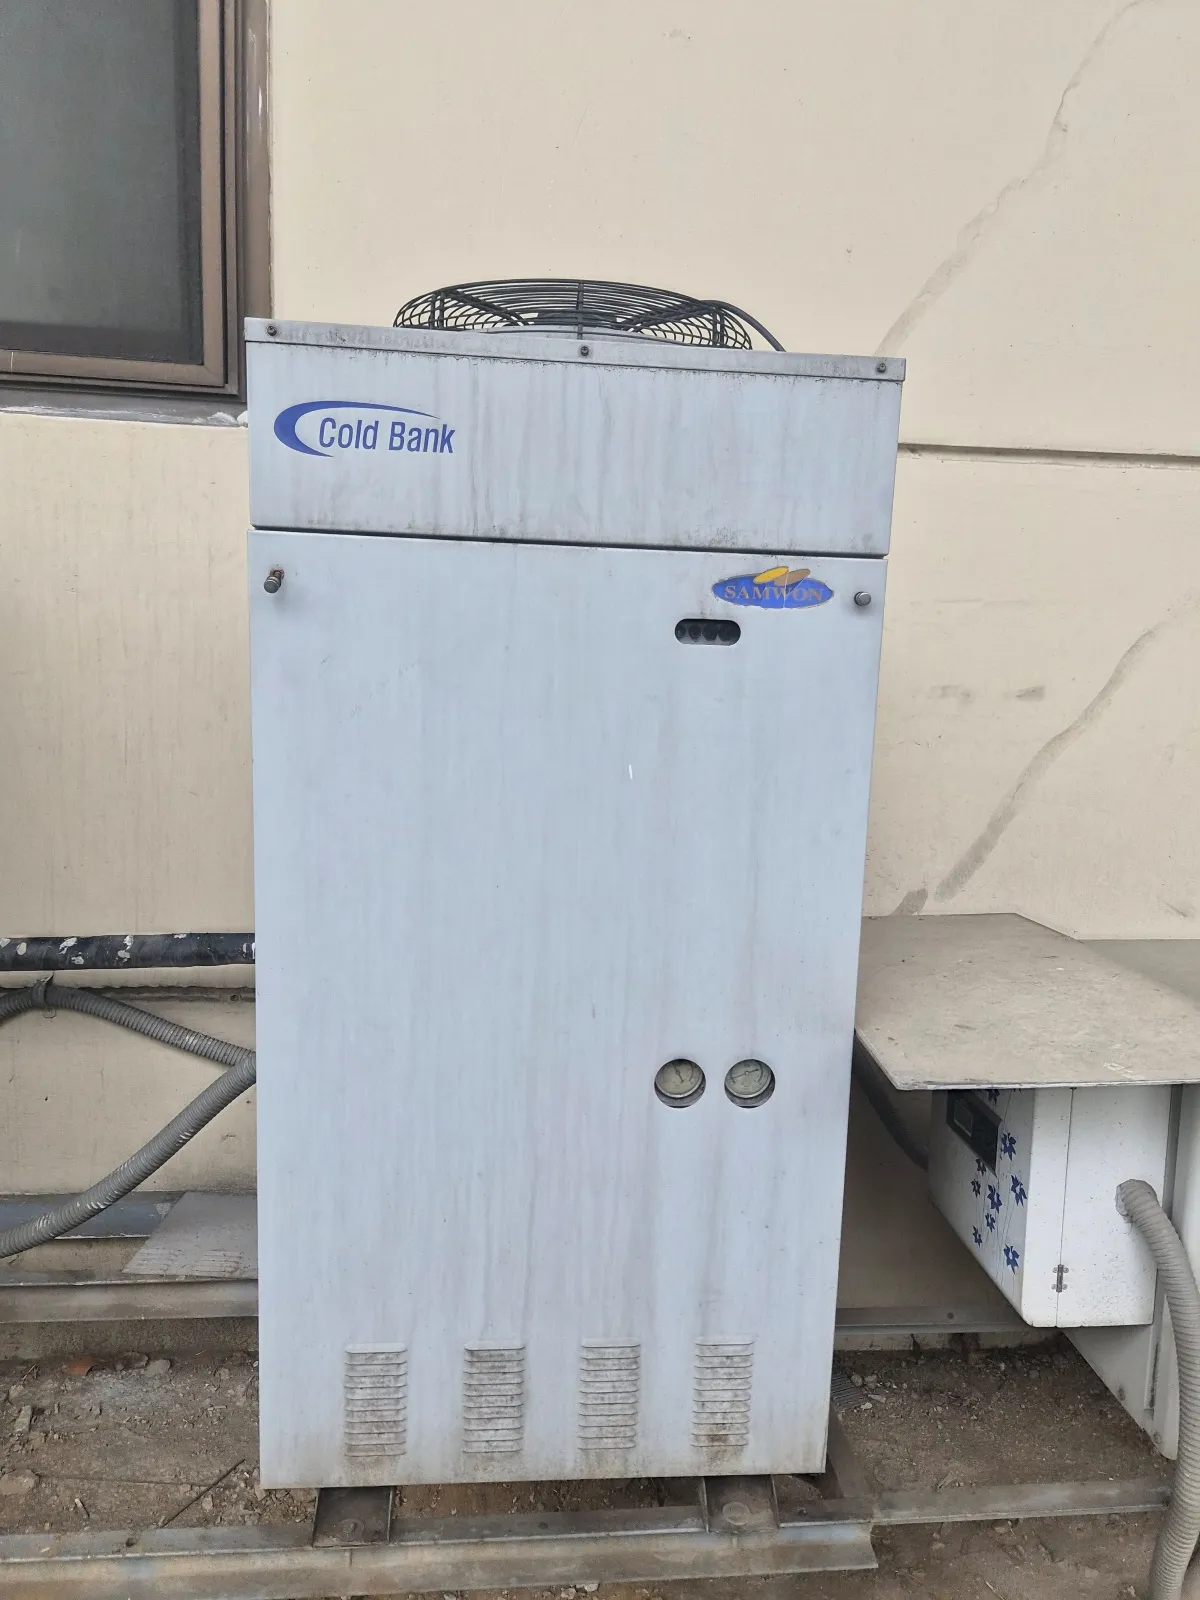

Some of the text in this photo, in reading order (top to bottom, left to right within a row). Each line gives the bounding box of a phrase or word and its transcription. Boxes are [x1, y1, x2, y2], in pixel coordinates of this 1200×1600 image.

[319, 417, 456, 453] Cold Bank
[724, 585, 823, 601] SAMWON
